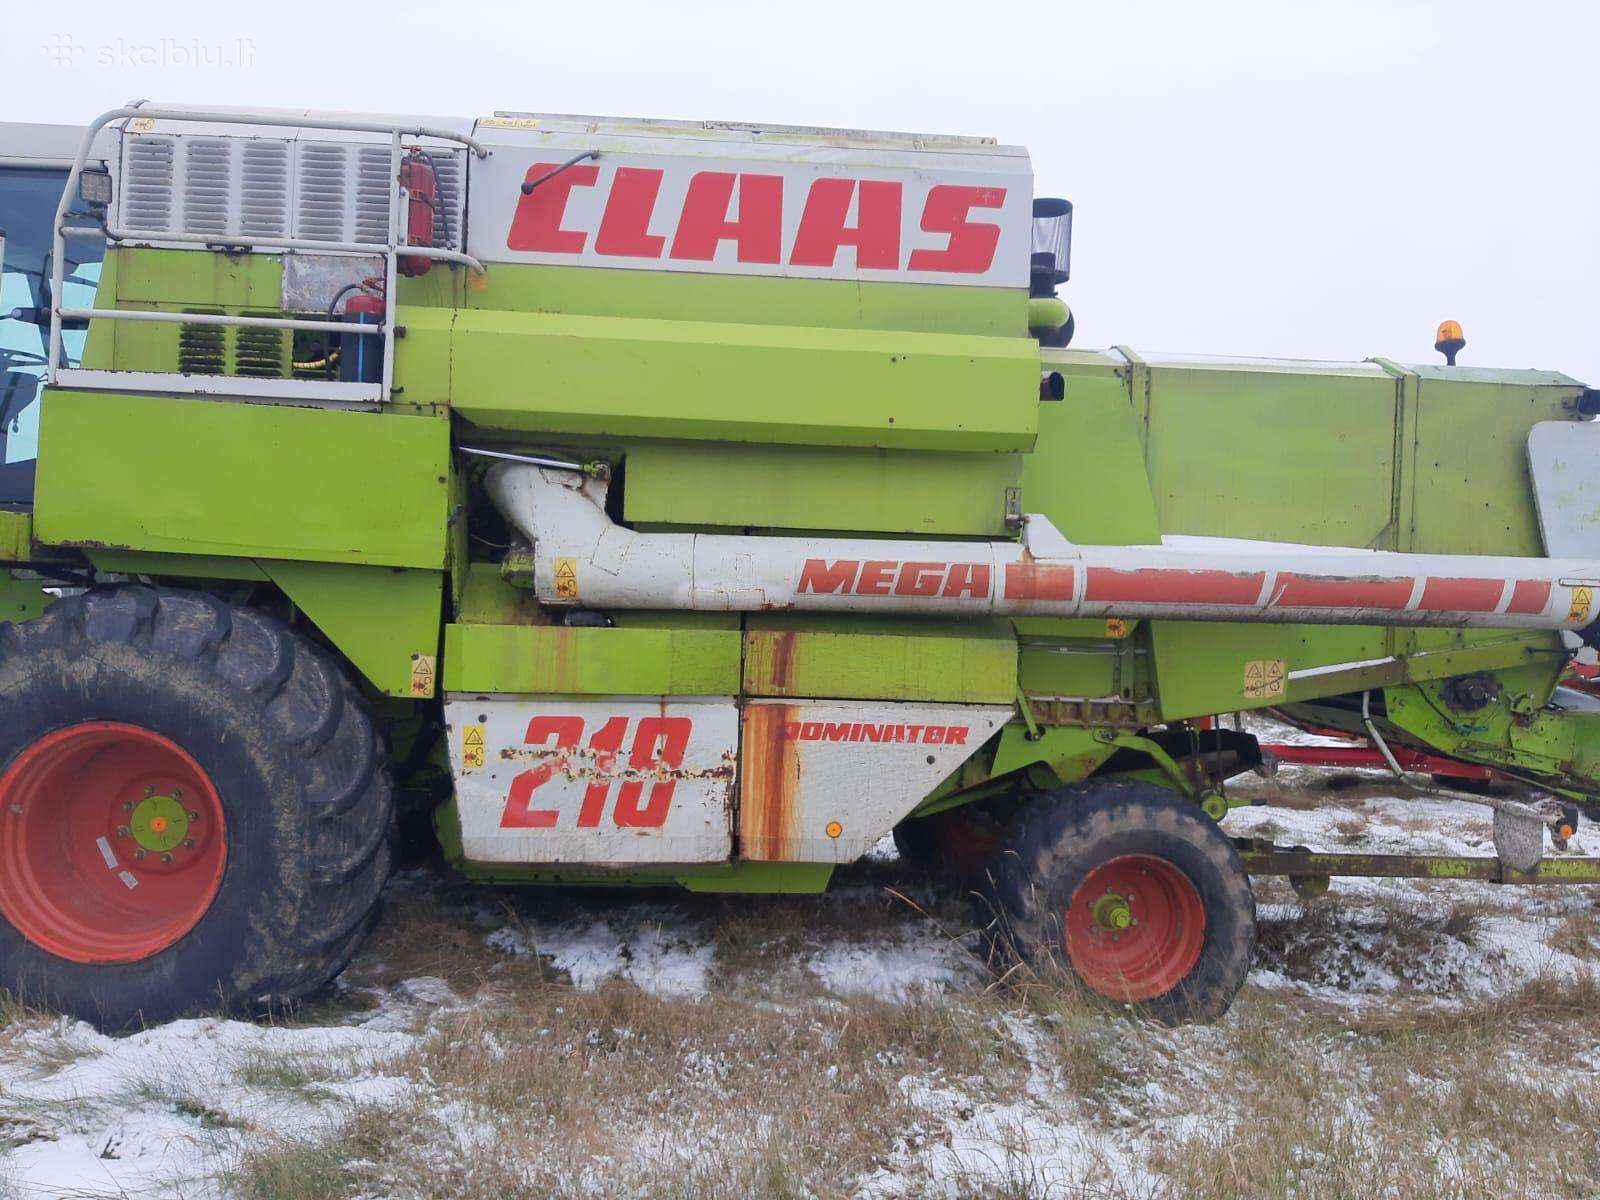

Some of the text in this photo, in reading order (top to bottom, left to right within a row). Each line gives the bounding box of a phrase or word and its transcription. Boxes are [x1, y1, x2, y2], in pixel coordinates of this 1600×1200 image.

[506, 162, 1007, 274] CLAAS
[797, 558, 991, 598] MEGA
[783, 721, 969, 745] DOMINATOR
[500, 715, 693, 828] 210
